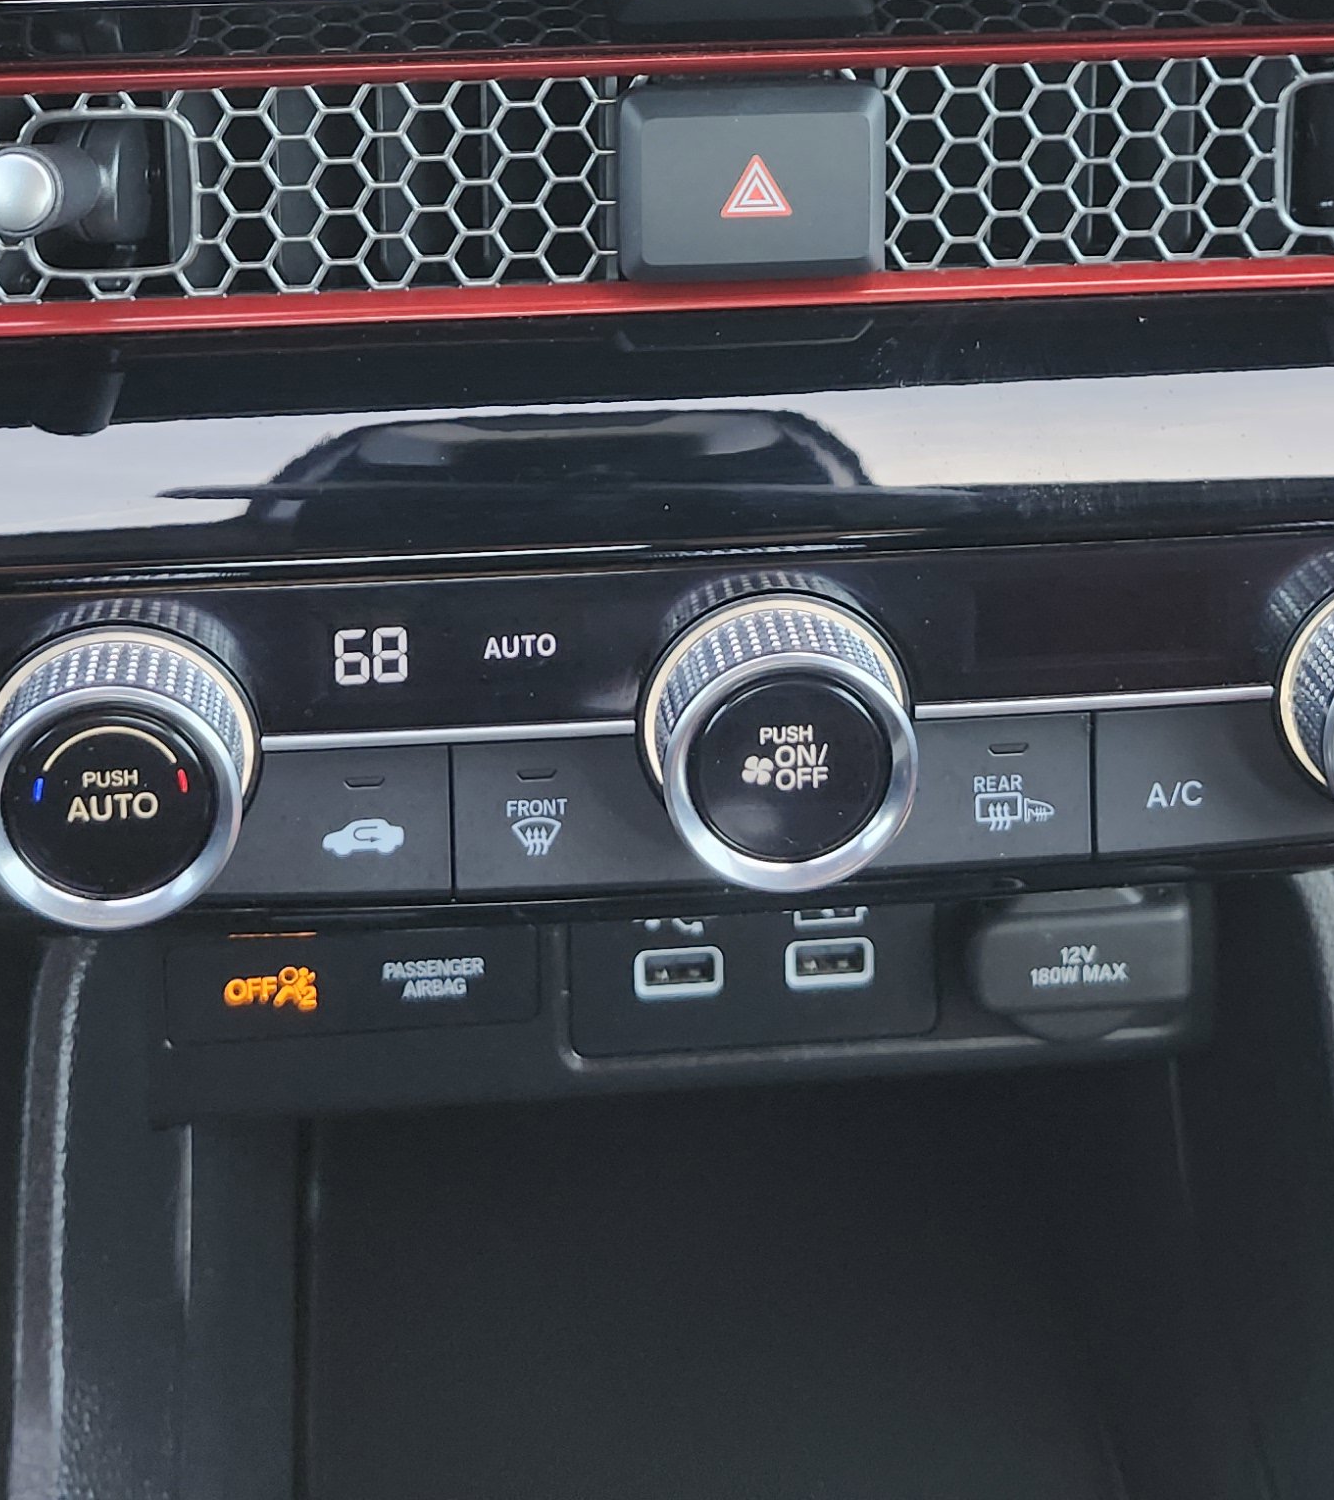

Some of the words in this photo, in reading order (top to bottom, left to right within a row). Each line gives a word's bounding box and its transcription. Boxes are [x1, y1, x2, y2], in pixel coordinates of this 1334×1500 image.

[334, 626, 408, 686] 68
[483, 633, 557, 660] AUTO
[759, 724, 814, 745] PUSH
[774, 742, 829, 771] ON/
[82, 769, 139, 790] PUSH
[775, 765, 829, 791] OFF
[973, 774, 1023, 794] REAR
[67, 790, 159, 823] AUTO
[1146, 780, 1203, 809] A/C
[506, 798, 568, 817] FRONT
[1060, 945, 1097, 965] 12V
[381, 957, 485, 981] PASSENGER
[1030, 965, 1080, 987] 180W
[1082, 962, 1129, 983] MAX
[223, 976, 279, 1007] OFF
[401, 977, 468, 1000] AIRBAG
